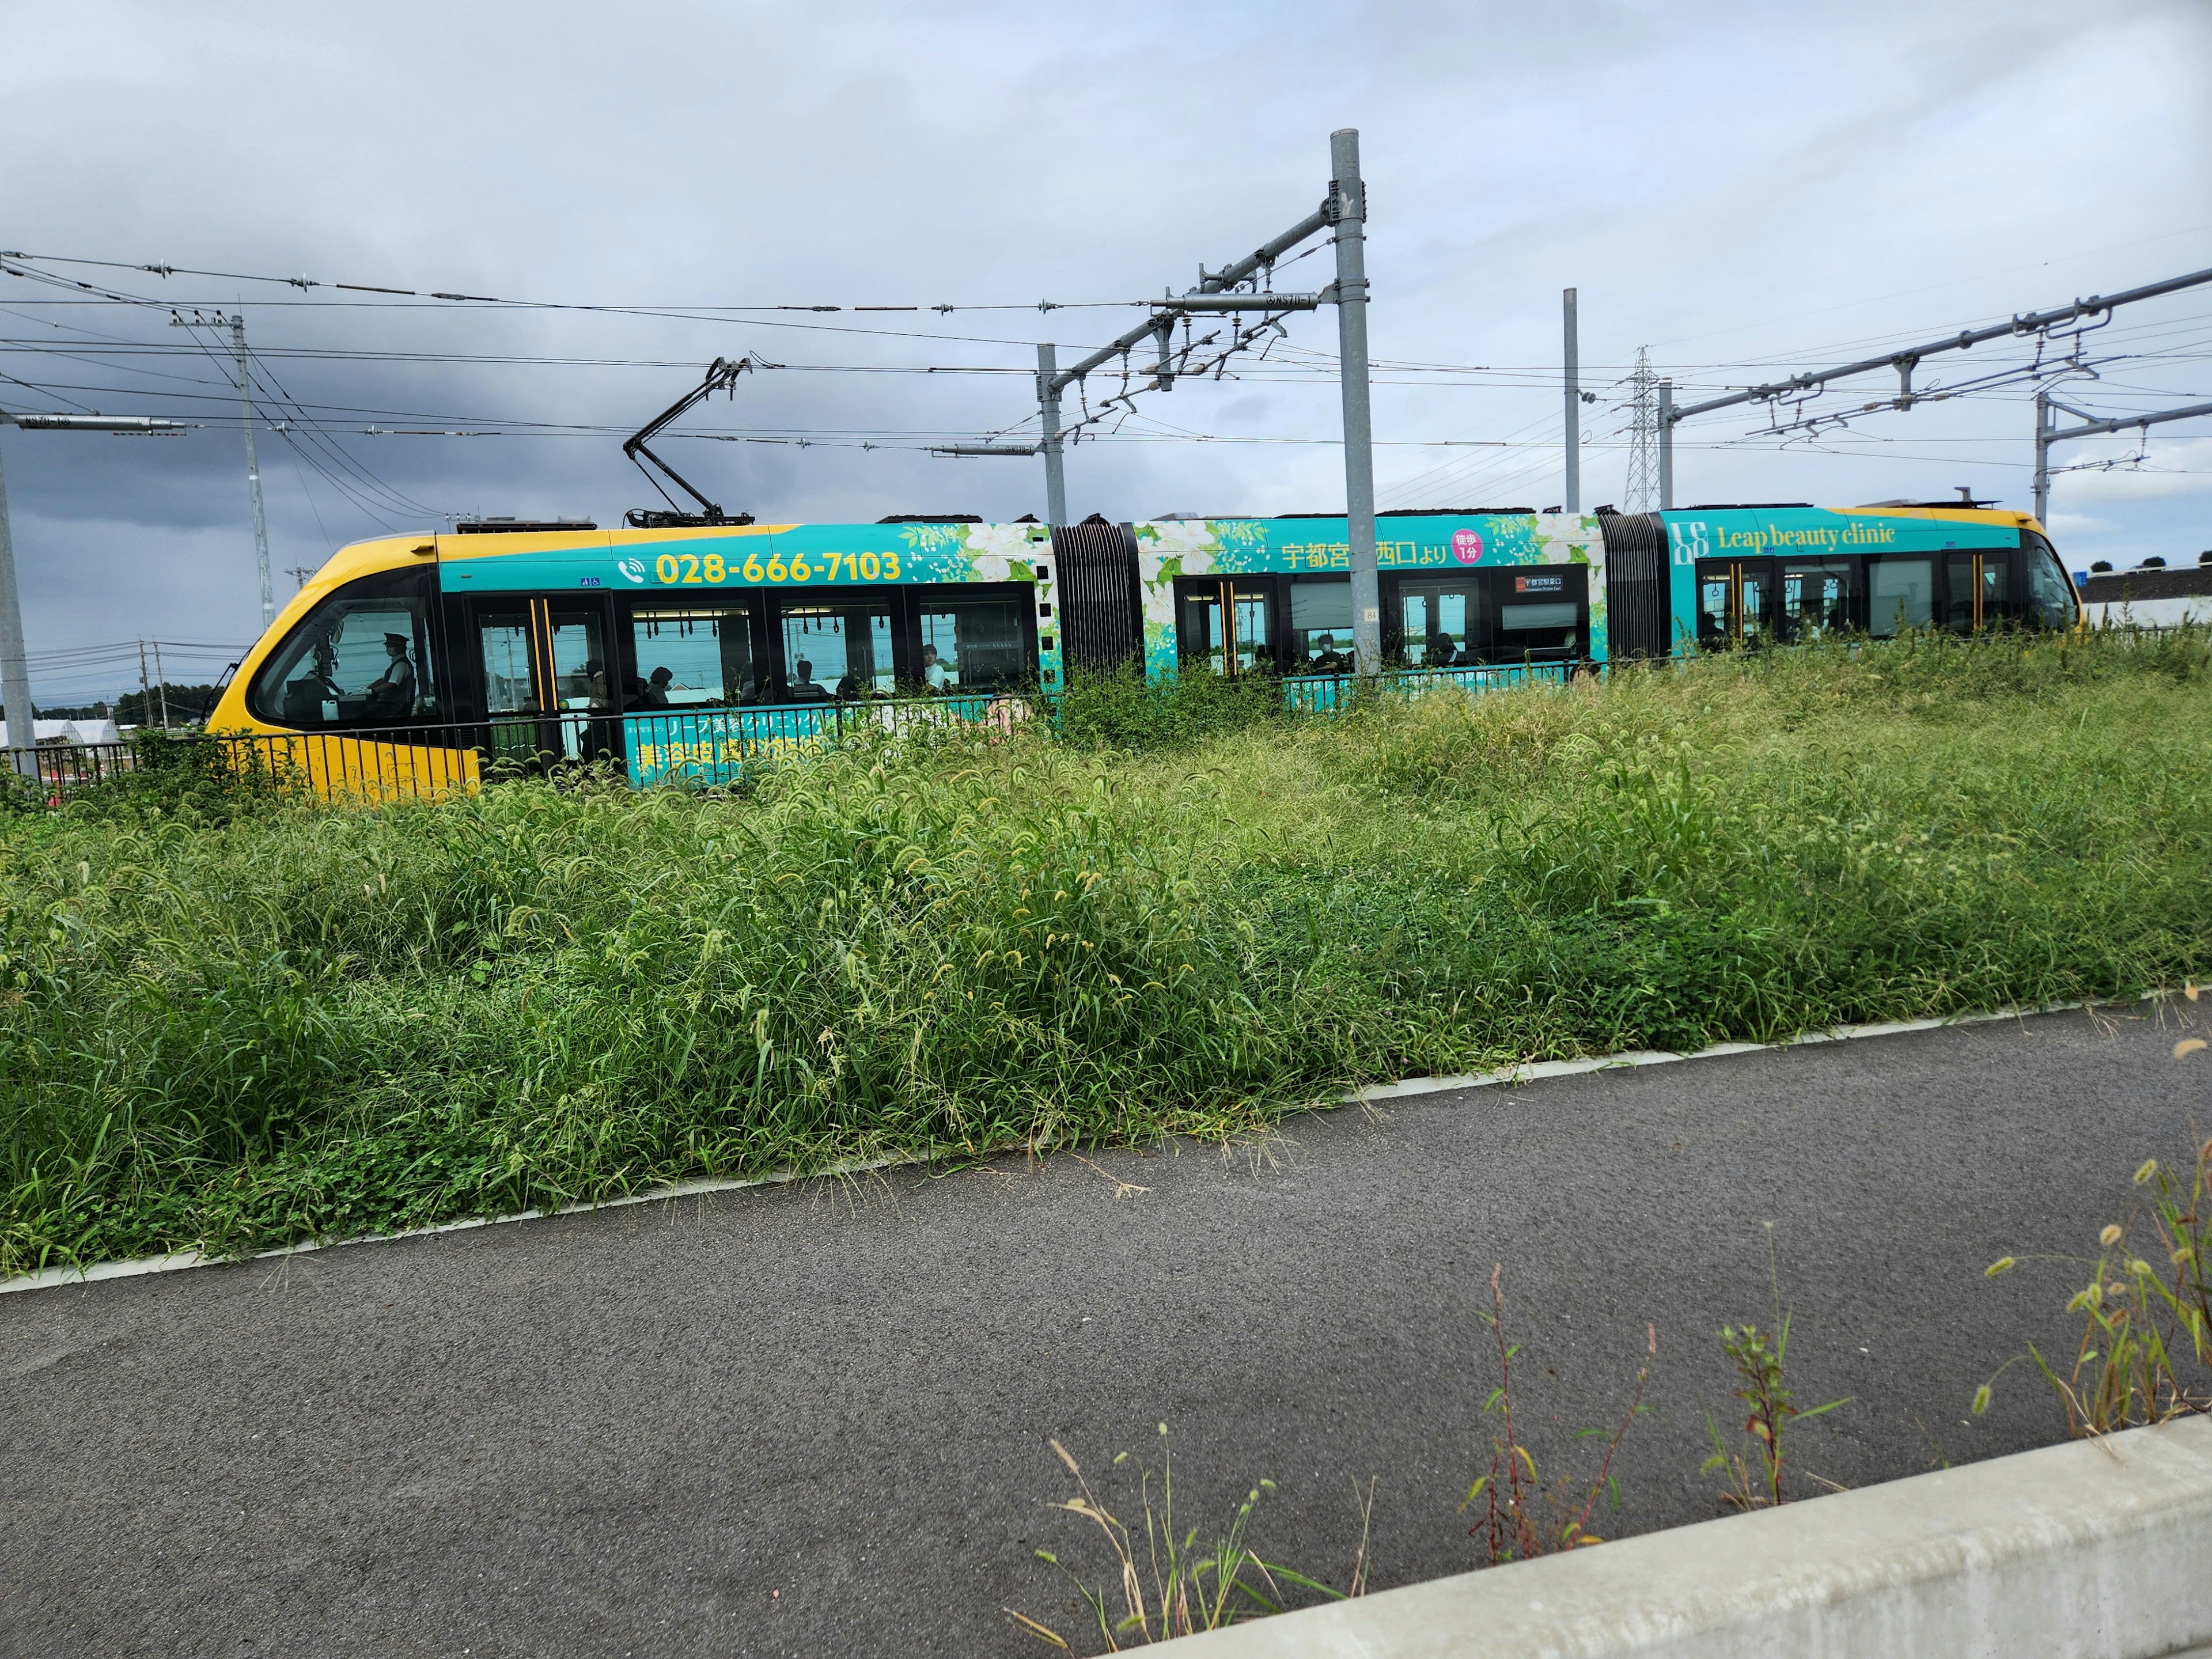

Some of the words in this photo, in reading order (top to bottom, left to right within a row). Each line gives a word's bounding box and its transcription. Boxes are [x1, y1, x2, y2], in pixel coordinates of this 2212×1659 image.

[1456, 534, 1476, 546] 徒歩
[1717, 527, 1768, 554] Leap
[1770, 524, 1838, 552] beauty
[1842, 522, 1896, 544] clinic
[1282, 541, 1446, 569] 宇都宮西口より
[1460, 547, 1476, 559] 1分
[656, 552, 900, 584] 028-666-7103
[1368, 611, 1376, 619] 84
